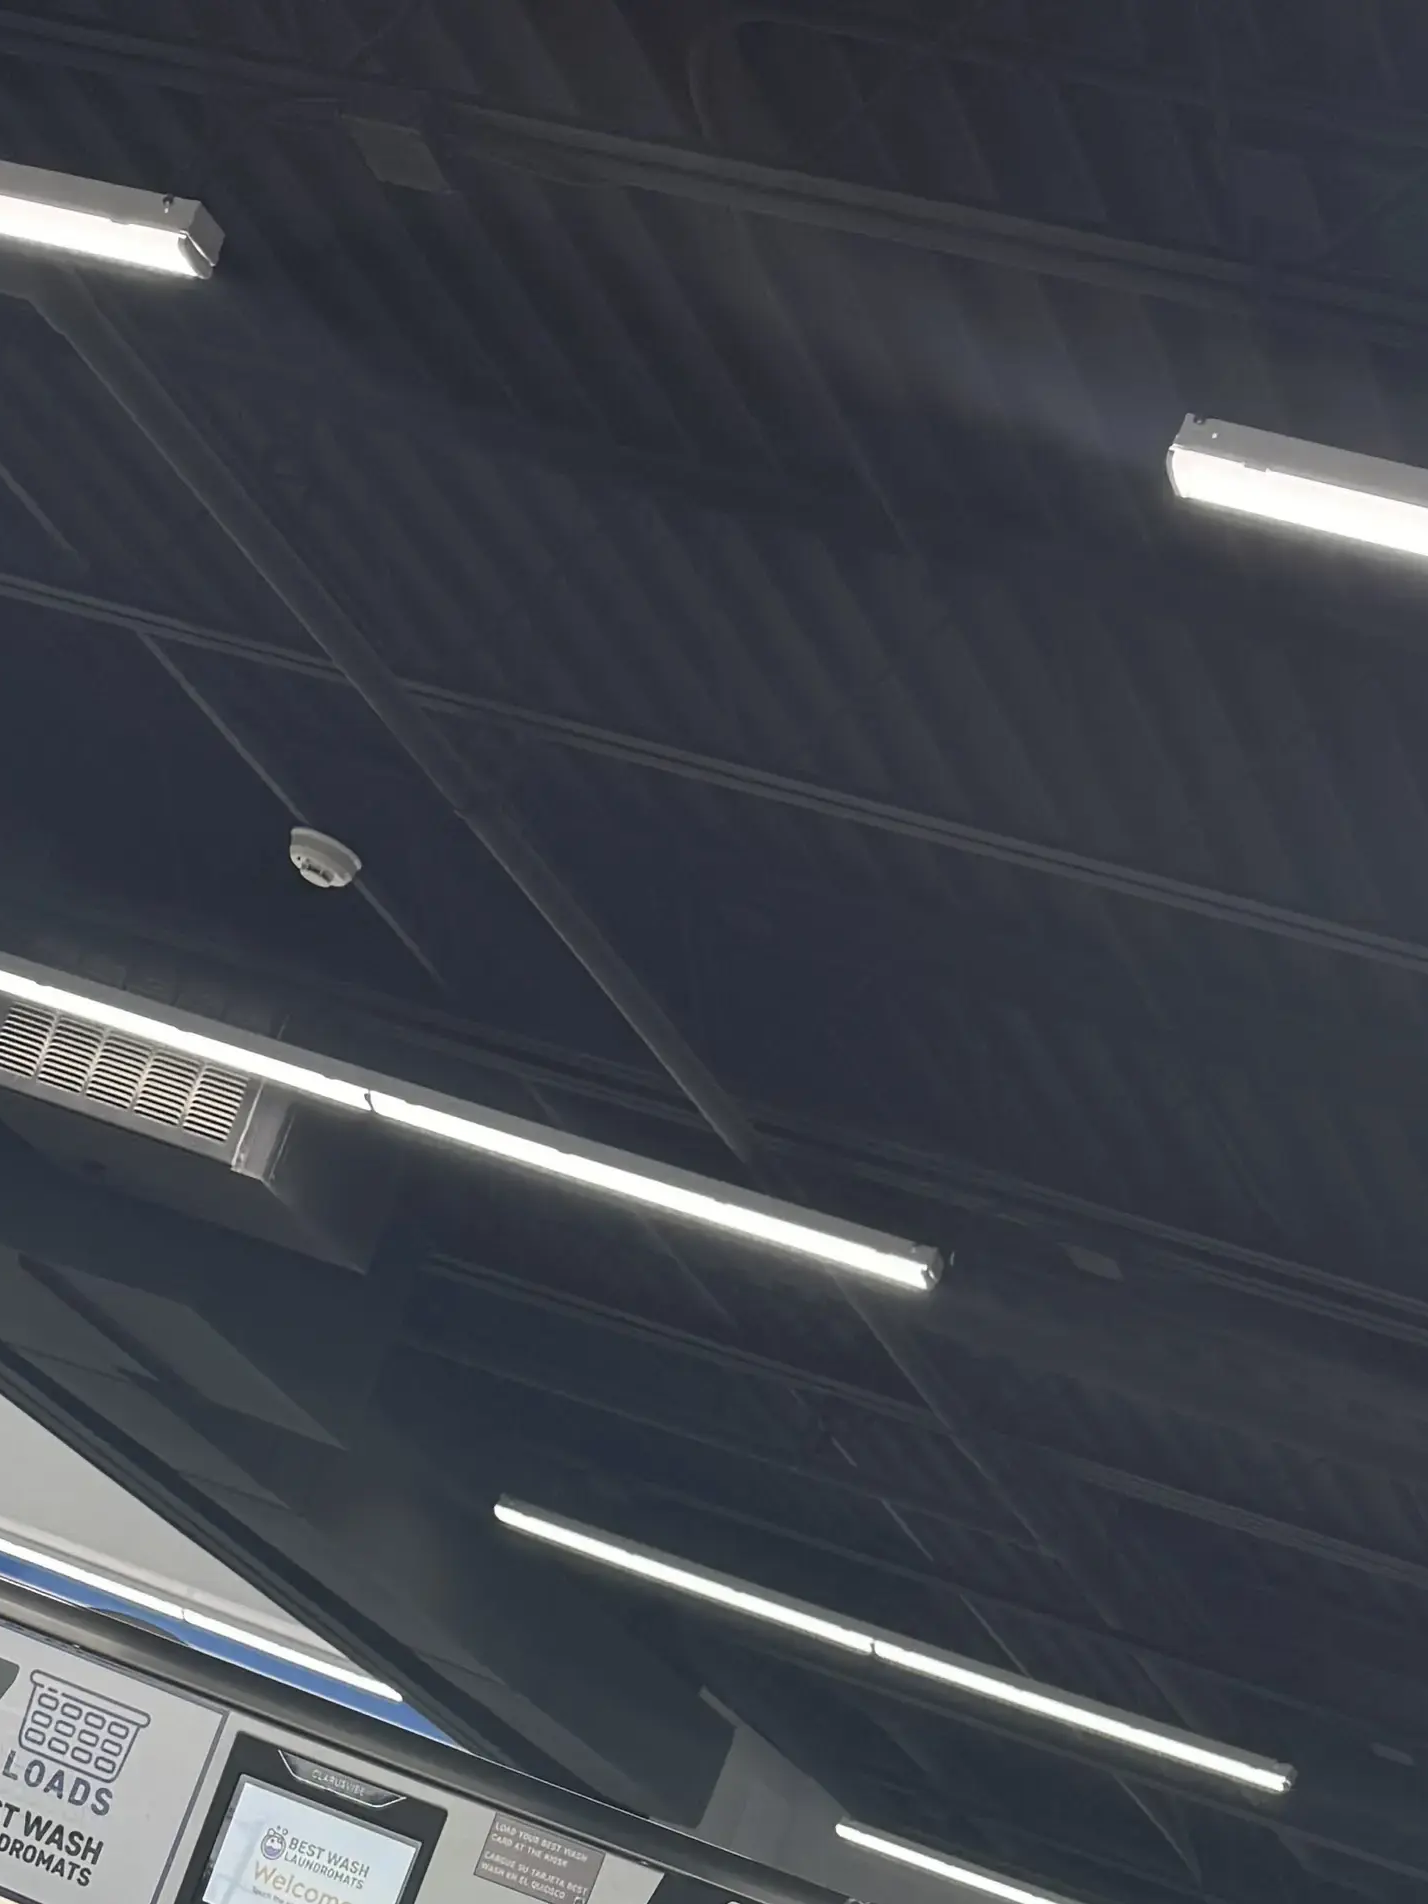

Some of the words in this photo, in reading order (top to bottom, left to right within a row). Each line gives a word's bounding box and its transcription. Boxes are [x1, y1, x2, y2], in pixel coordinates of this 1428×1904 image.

[2, 1749, 113, 1816] LOADS
[23, 1810, 104, 1865] WASH
[289, 1837, 325, 1860] BEST
[327, 1851, 370, 1877] WASH
[284, 1852, 364, 1890] LAUNDROMATS
